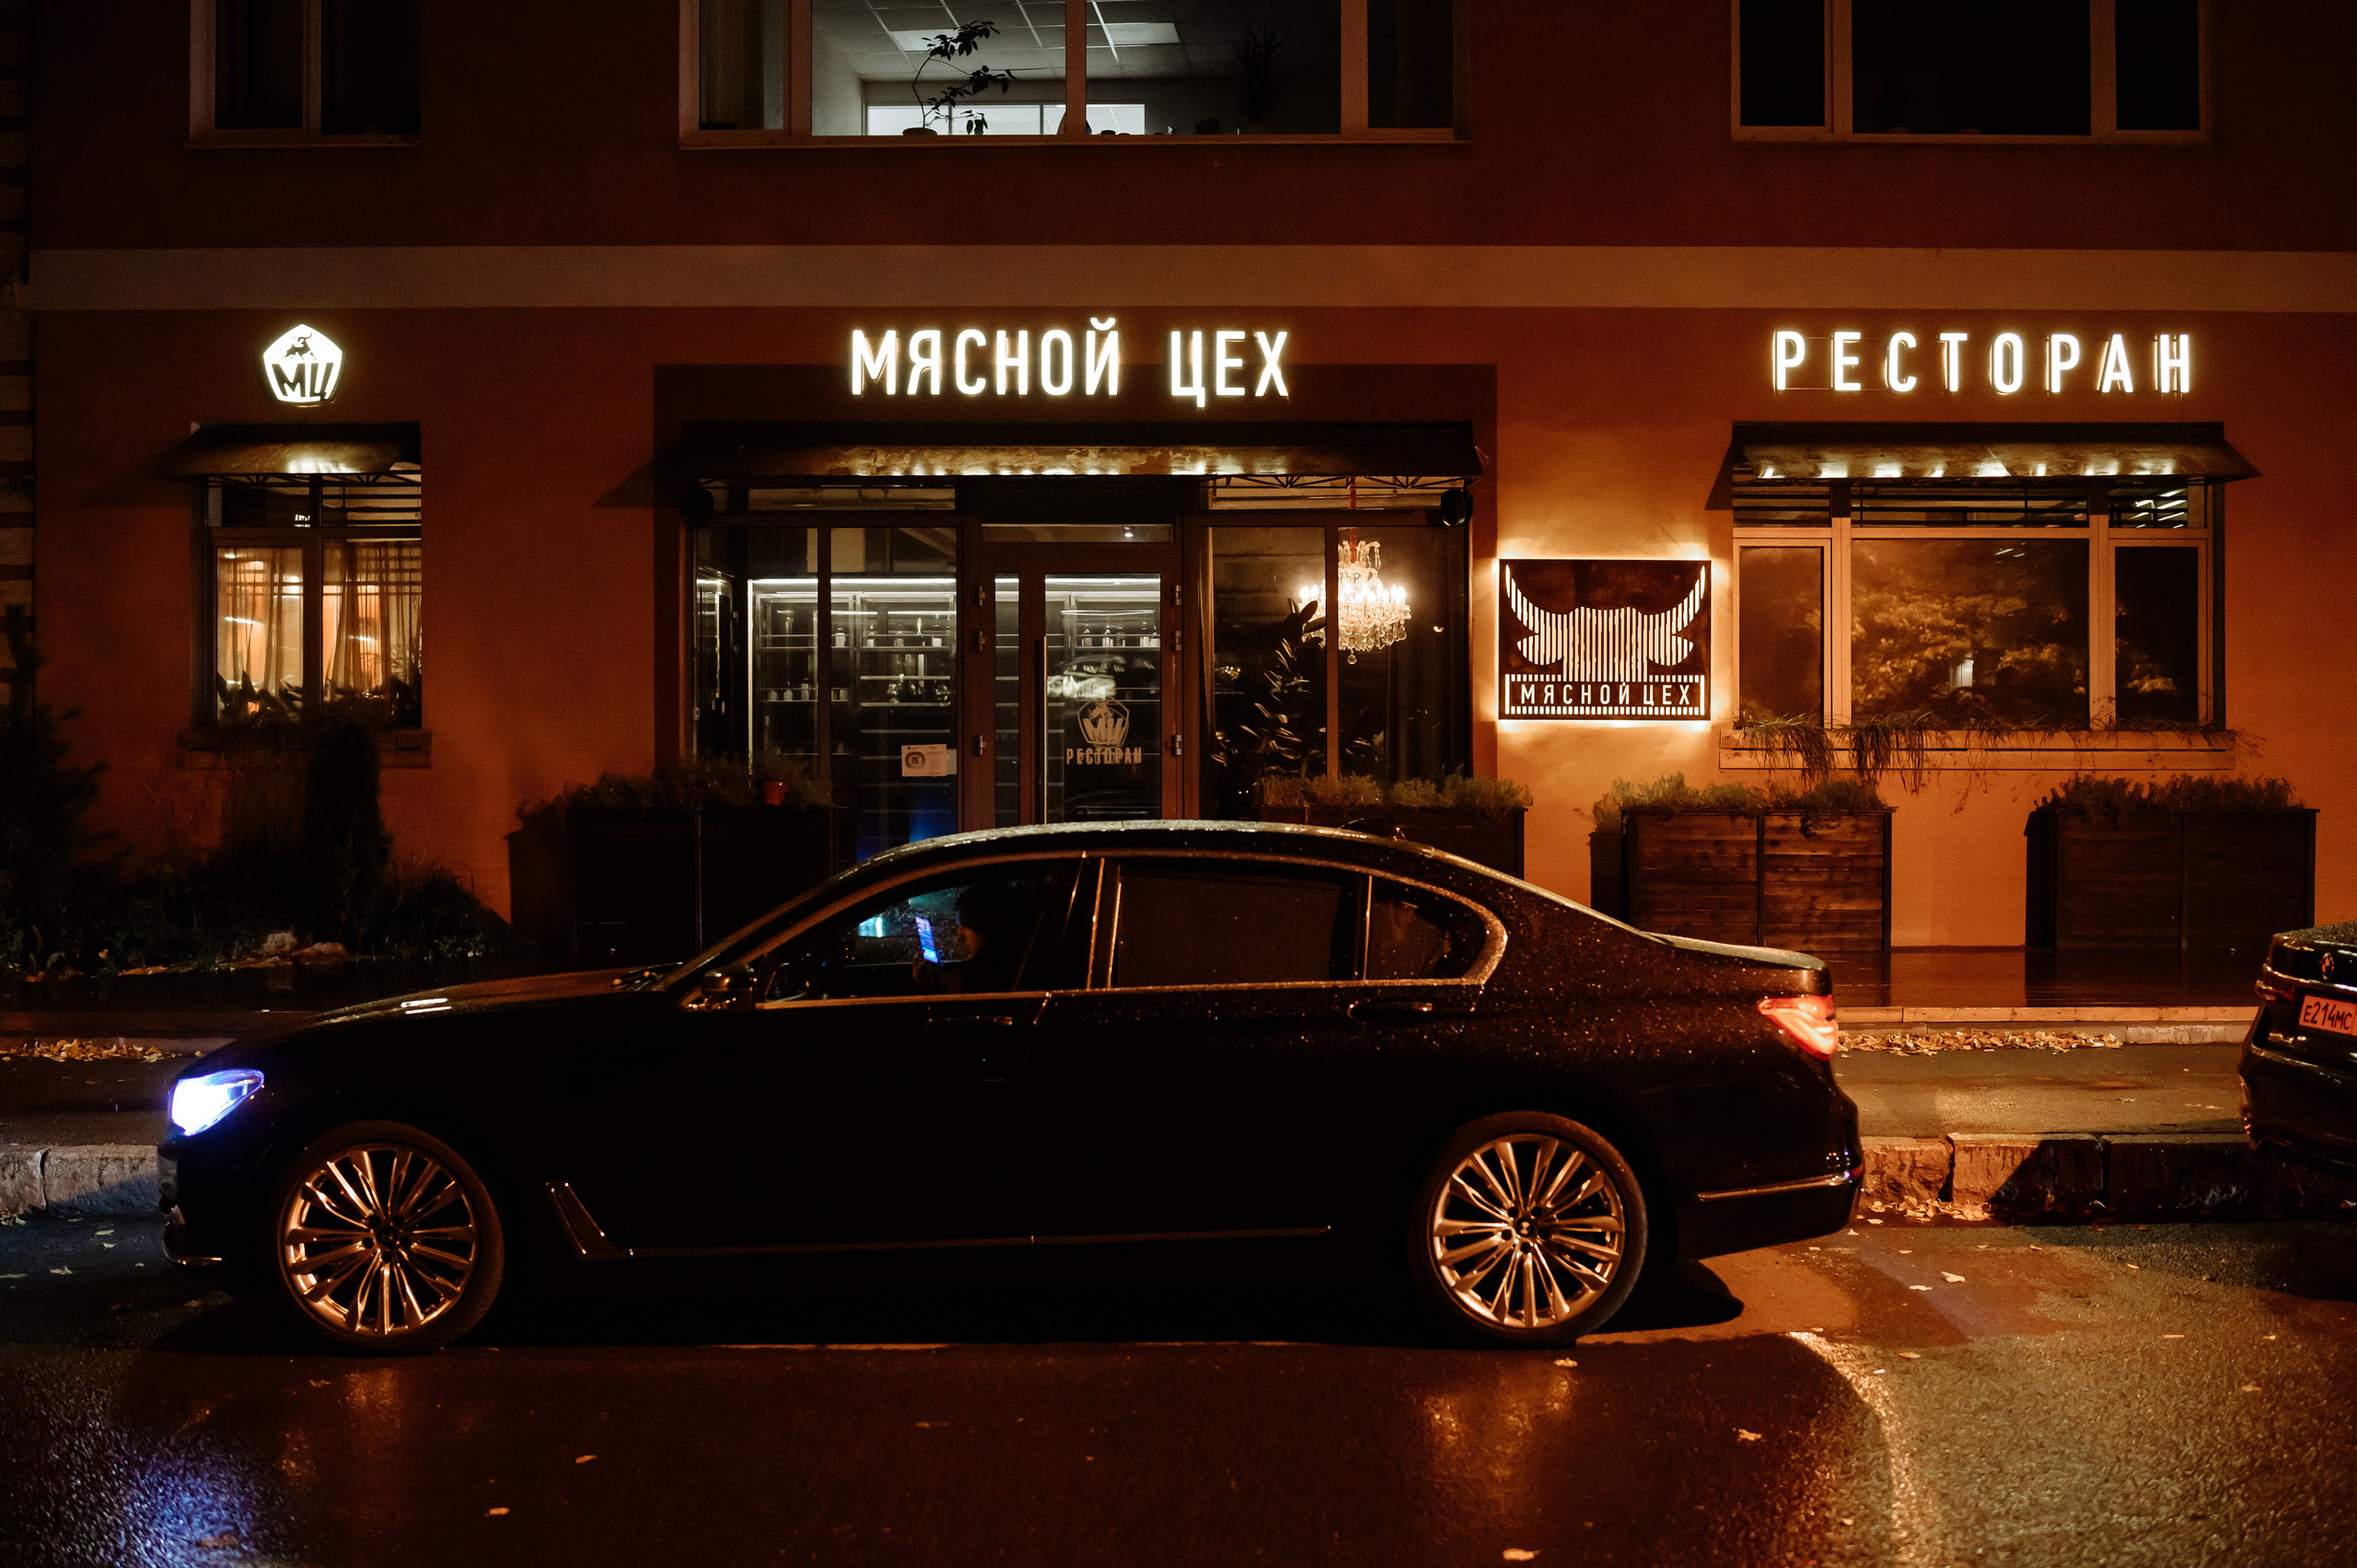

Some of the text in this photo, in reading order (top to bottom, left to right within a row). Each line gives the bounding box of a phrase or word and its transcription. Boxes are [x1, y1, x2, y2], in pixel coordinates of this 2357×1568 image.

[272, 362, 333, 400] МЦ
[852, 318, 1289, 408] МЯСНОЙ ЦЕХ
[1775, 331, 2189, 394] РЕСТОРАН
[1521, 682, 1690, 706] МЯСНОЙ ЦЕХ
[1066, 747, 1142, 765] РЕСТОРАН
